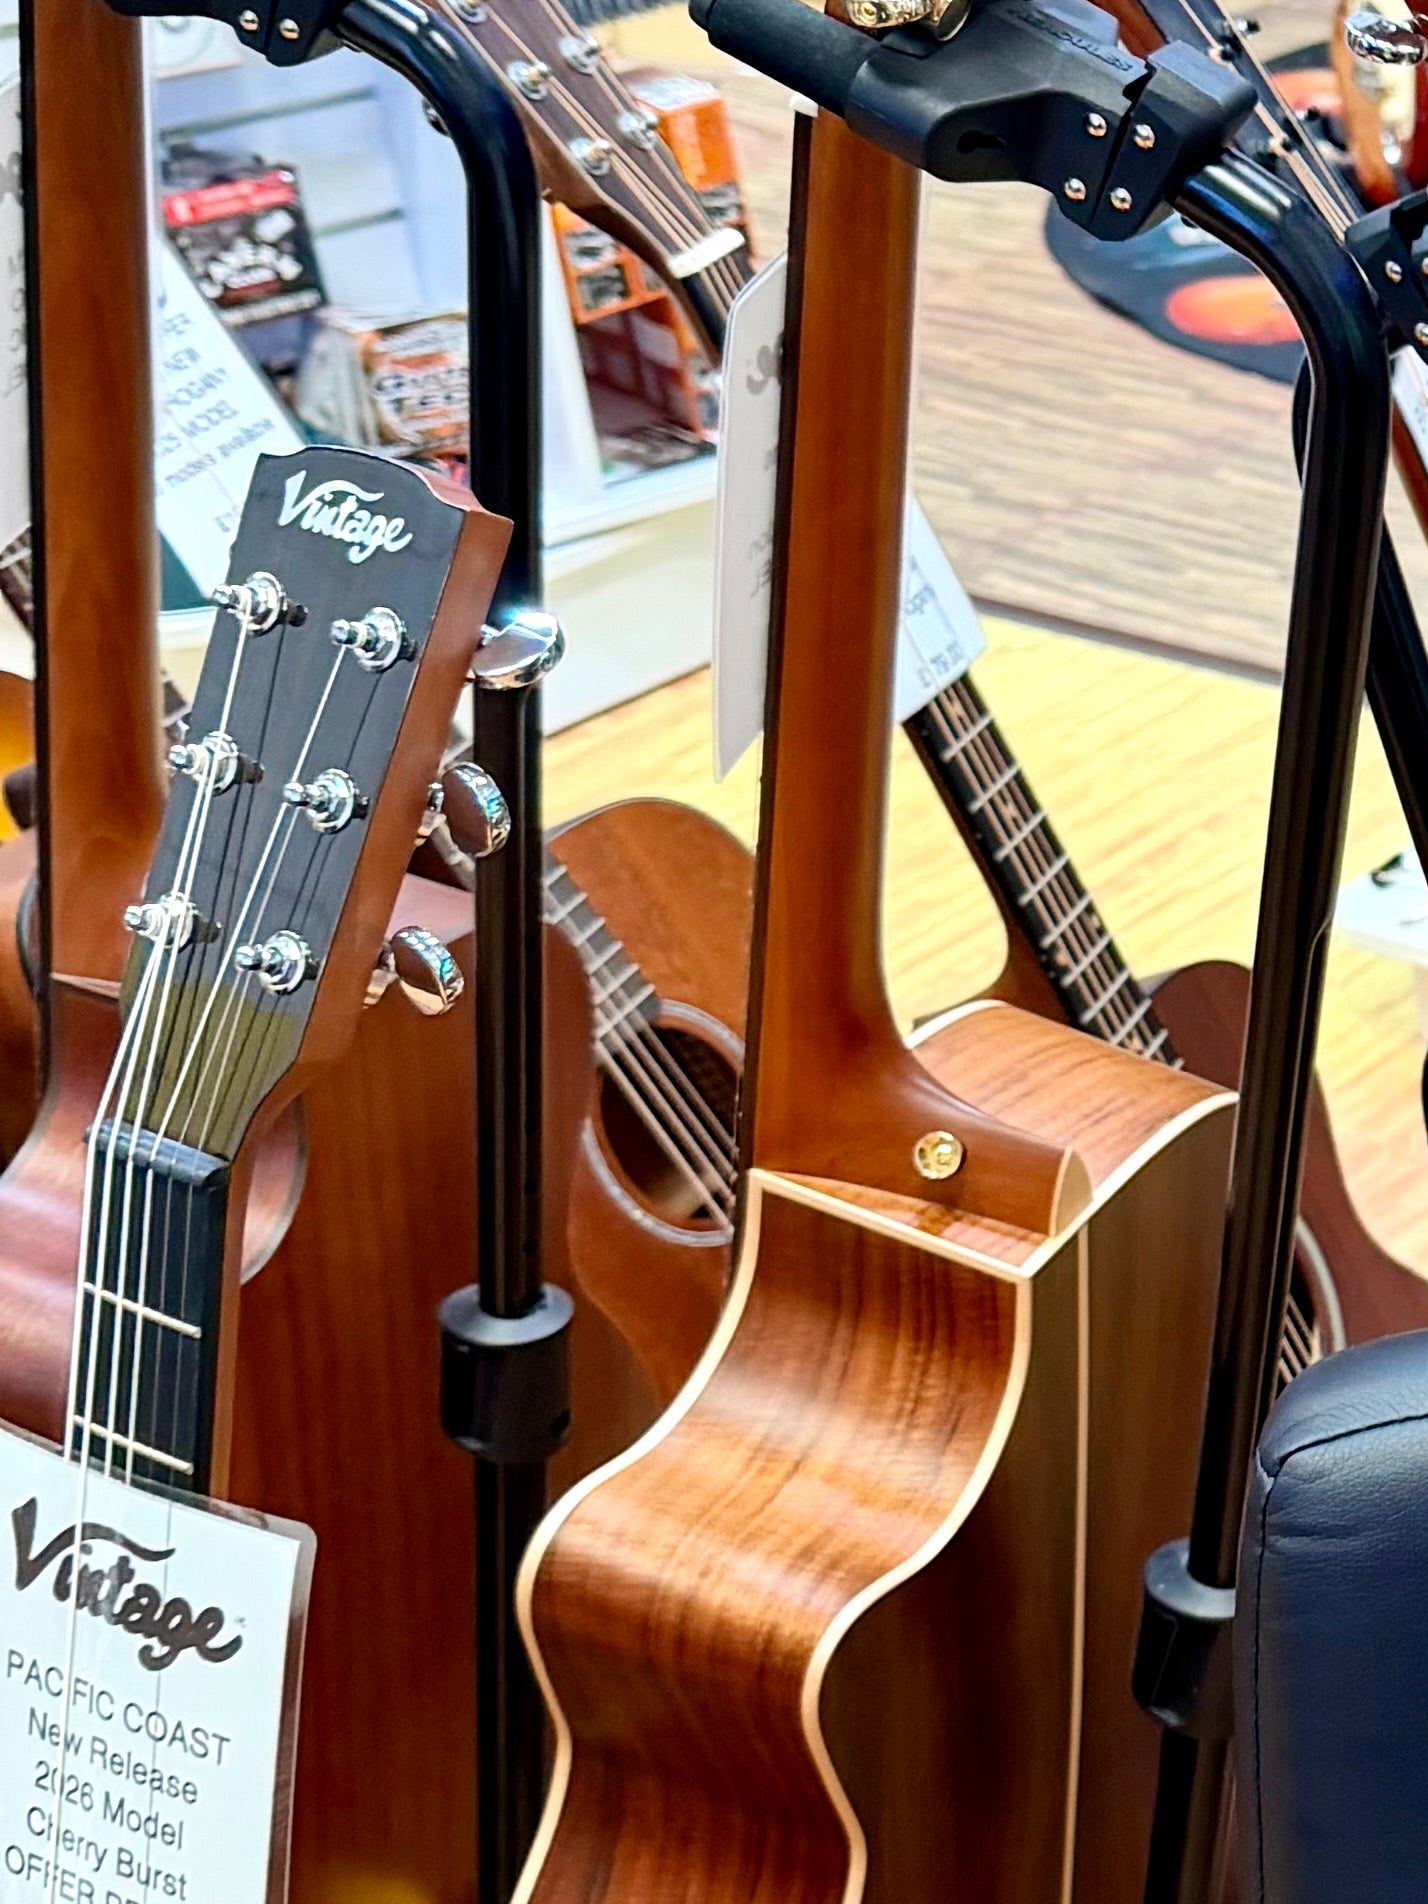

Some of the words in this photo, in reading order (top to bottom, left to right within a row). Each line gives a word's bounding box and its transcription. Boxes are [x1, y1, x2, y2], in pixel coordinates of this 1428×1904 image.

[278, 470, 413, 564] Vintage
[12, 1496, 243, 1672] Vintage
[7, 1648, 115, 1722] PACFIC
[123, 1702, 231, 1765] COAST
[28, 1707, 84, 1757] New
[90, 1735, 198, 1805] Release
[103, 1790, 185, 1850] Model
[117, 1846, 188, 1902] Burst
